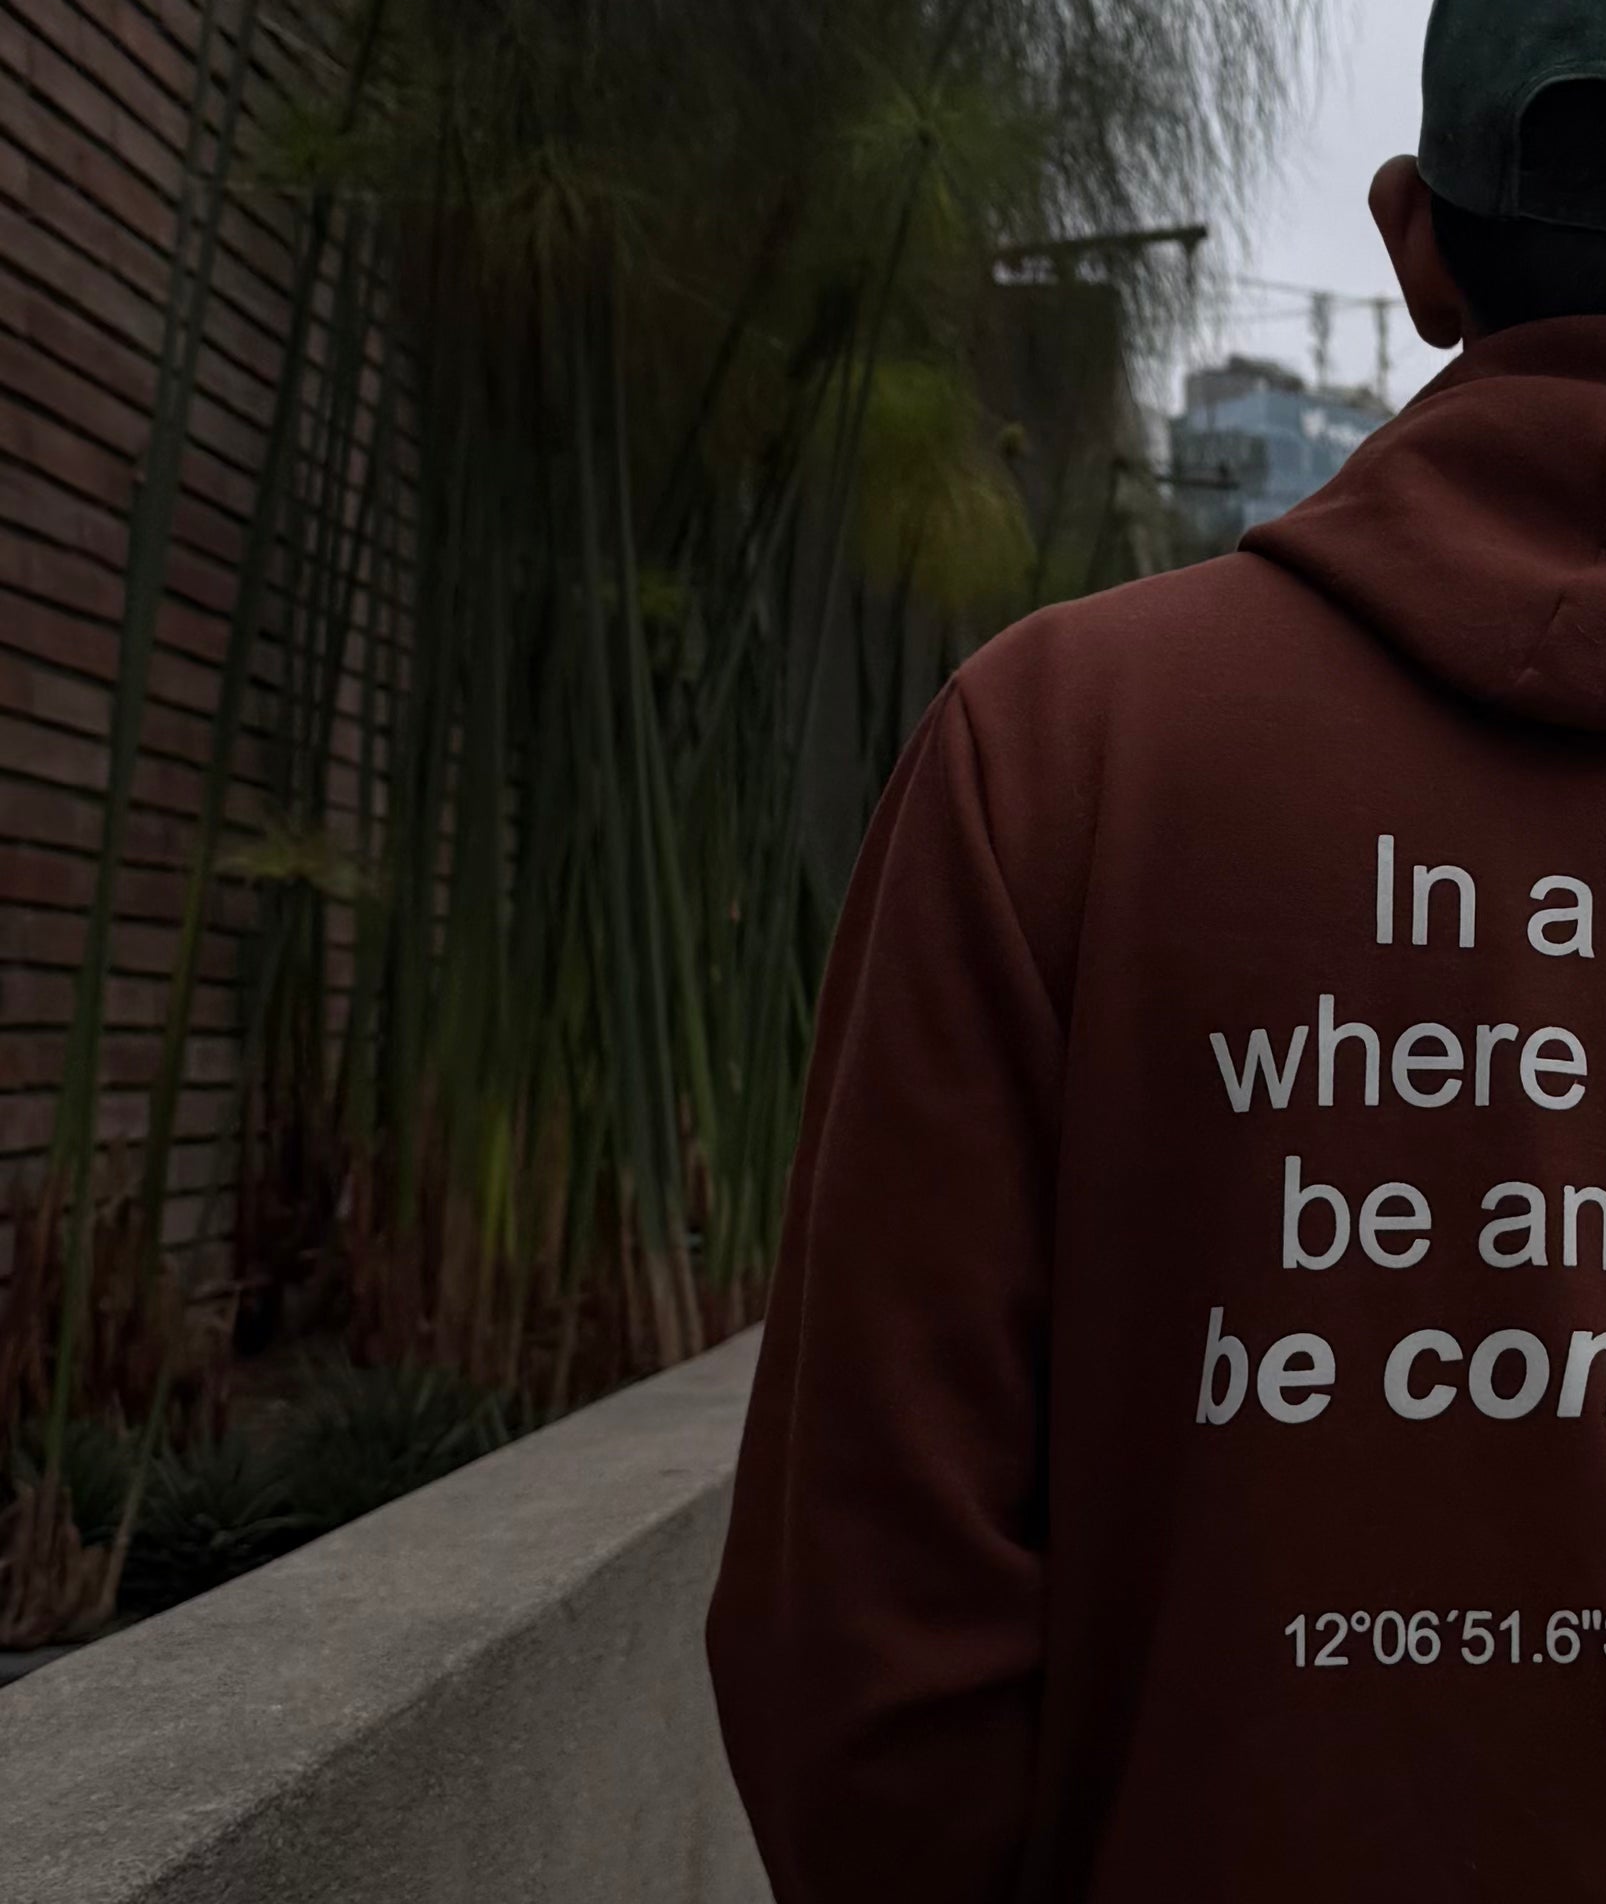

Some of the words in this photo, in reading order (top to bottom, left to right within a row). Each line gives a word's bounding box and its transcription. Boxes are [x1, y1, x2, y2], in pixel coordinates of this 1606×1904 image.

[1376, 834, 1476, 948] In
[1526, 874, 1595, 959] a
[1209, 993, 1588, 1113] where
[1282, 1155, 1432, 1271] be
[1196, 1306, 1336, 1425] be
